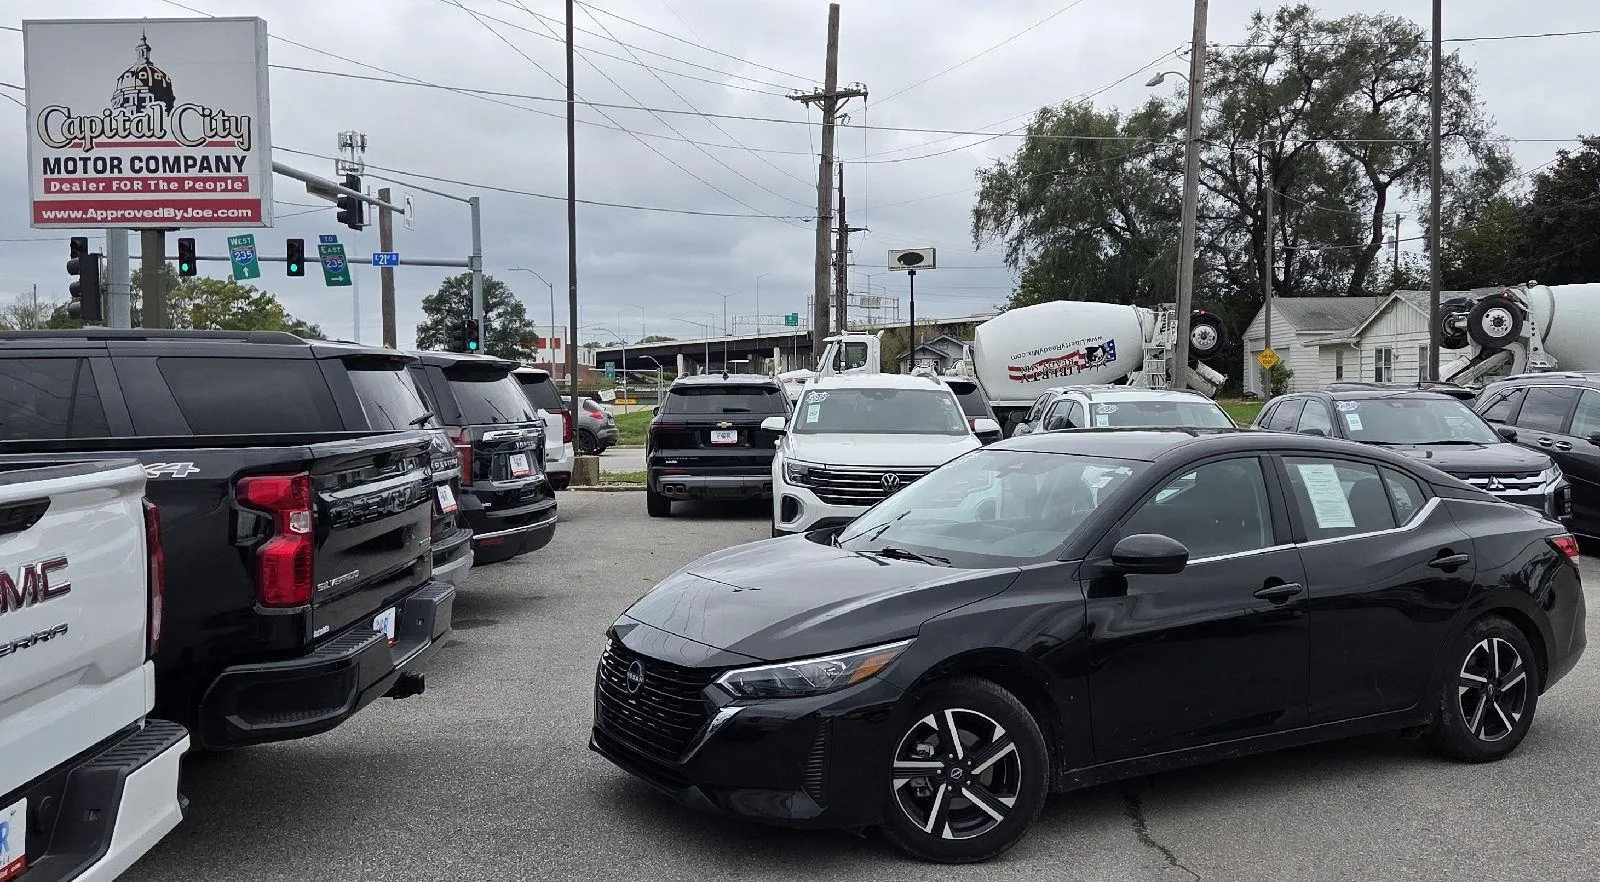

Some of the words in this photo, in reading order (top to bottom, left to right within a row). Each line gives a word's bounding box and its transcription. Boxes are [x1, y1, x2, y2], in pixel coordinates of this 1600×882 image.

[37, 101, 167, 152] Capital
[171, 103, 251, 151] City
[42, 157, 123, 175] MOTOR
[129, 155, 247, 174] COMPANY
[50, 180, 105, 192] Dealer
[112, 181, 143, 191] FOR
[147, 180, 178, 191] The
[184, 180, 243, 192] People
[42, 208, 252, 221] www.ApprovedByJoe.com
[230, 237, 251, 246] WEST
[234, 251, 253, 261] 235
[326, 259, 344, 268] 235
